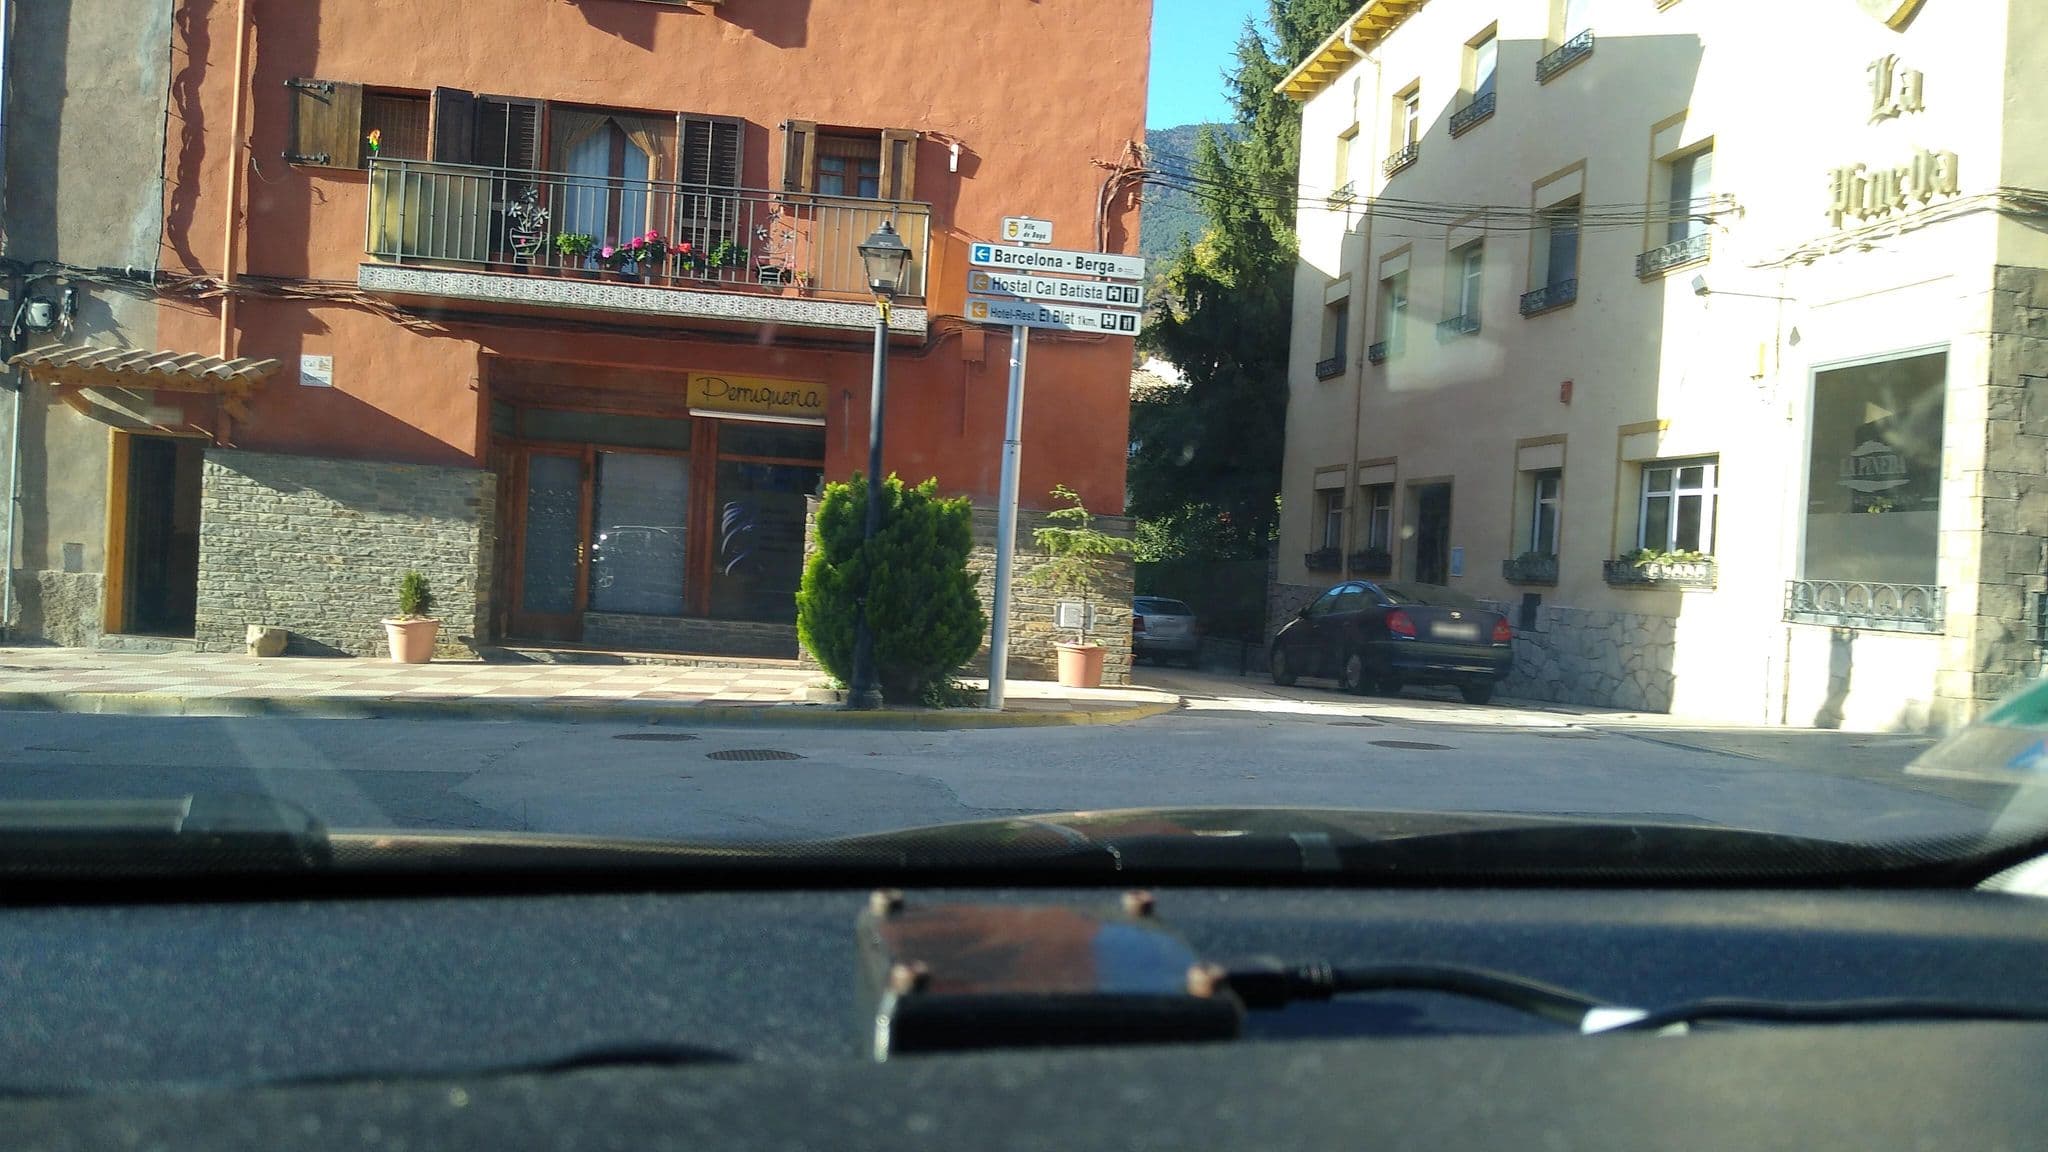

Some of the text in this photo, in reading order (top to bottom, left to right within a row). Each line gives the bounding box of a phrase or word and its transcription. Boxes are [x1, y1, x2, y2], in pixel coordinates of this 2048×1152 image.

[1866, 53, 1926, 126] La
[994, 249, 1063, 268] Barcelona
[1076, 256, 1115, 275] Berga
[992, 277, 1032, 293] Hostal
[1036, 280, 1056, 295] Cal
[1060, 283, 1103, 299] Batista
[1039, 308, 1050, 322] El
[1053, 310, 1074, 325] Blat
